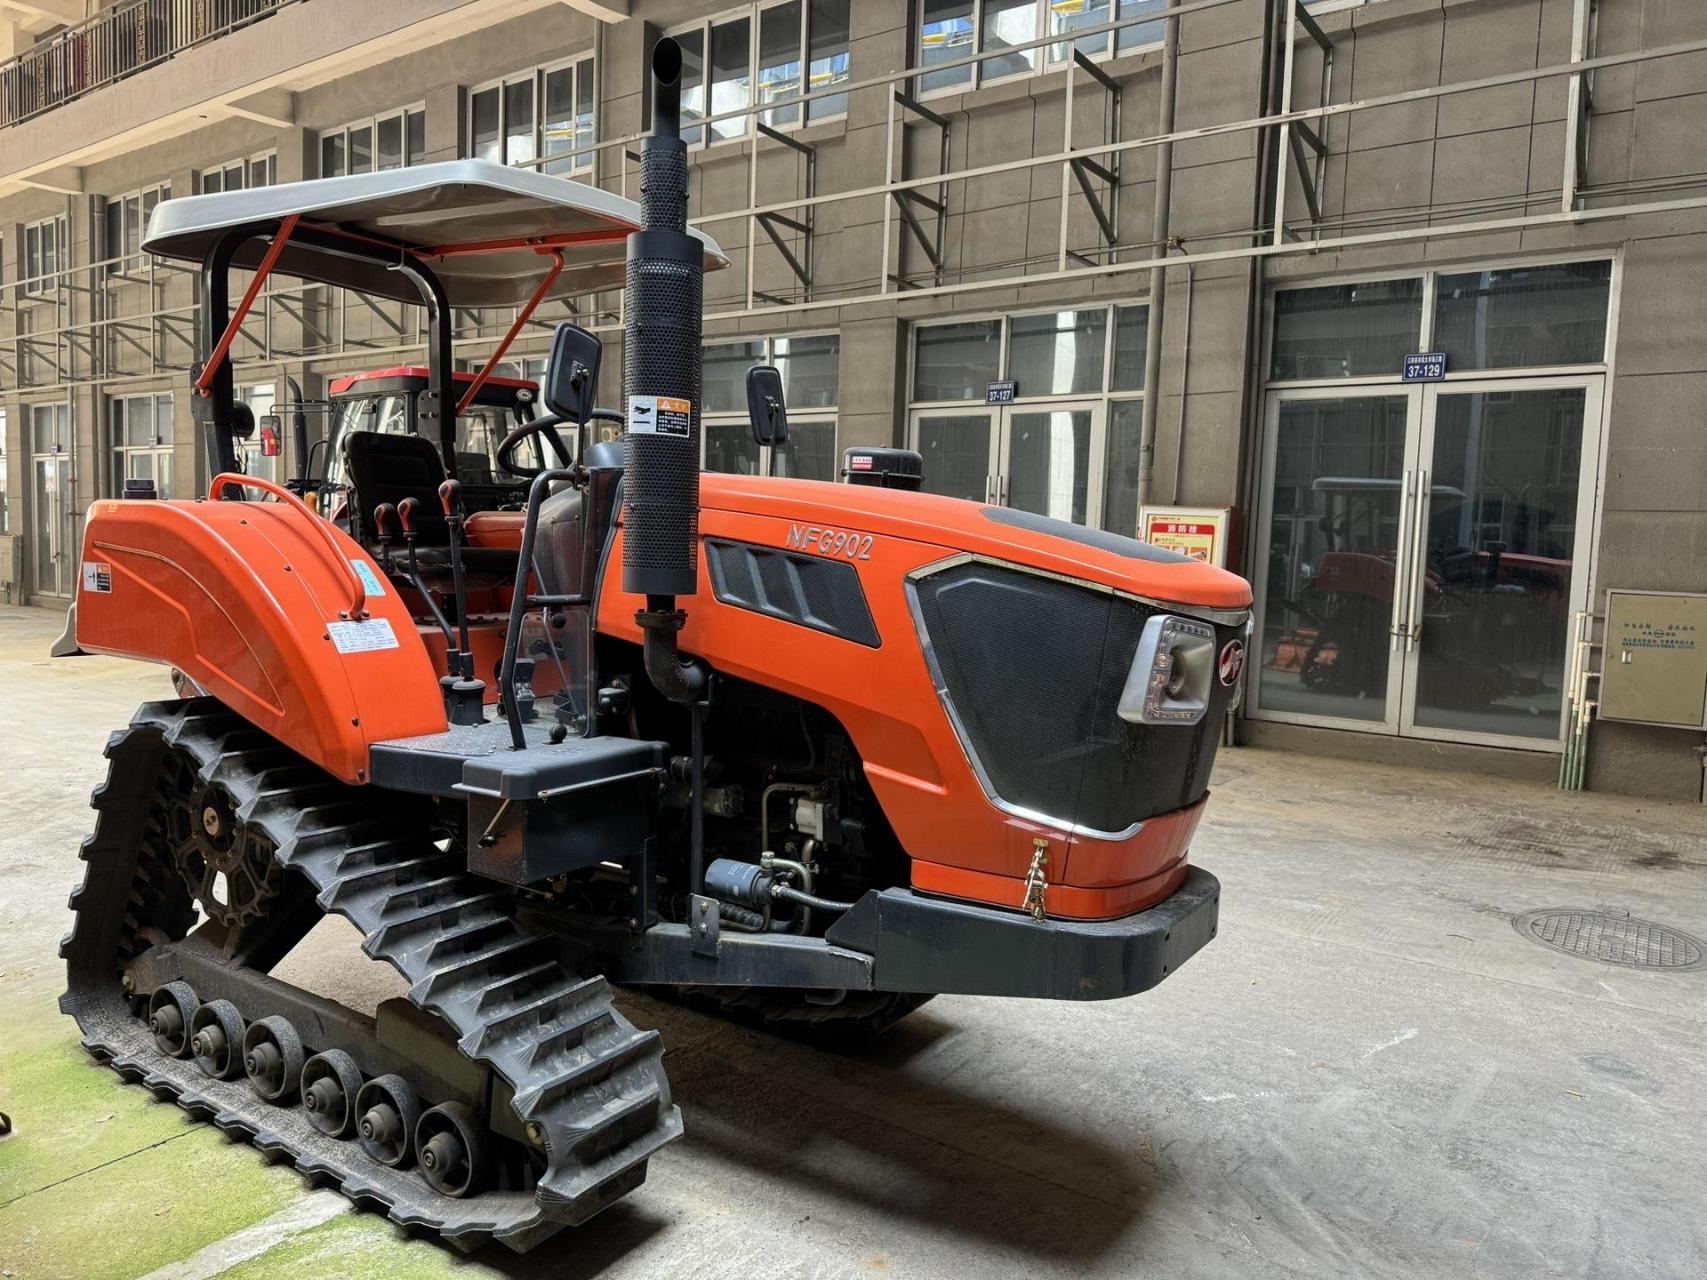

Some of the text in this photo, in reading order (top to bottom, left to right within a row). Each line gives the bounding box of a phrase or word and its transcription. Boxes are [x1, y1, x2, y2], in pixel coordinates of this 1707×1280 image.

[1408, 365, 1440, 377] 37-129
[989, 390, 1010, 401] 37-127
[1167, 524, 1198, 534] 消防栓
[785, 524, 873, 560] NFG902
